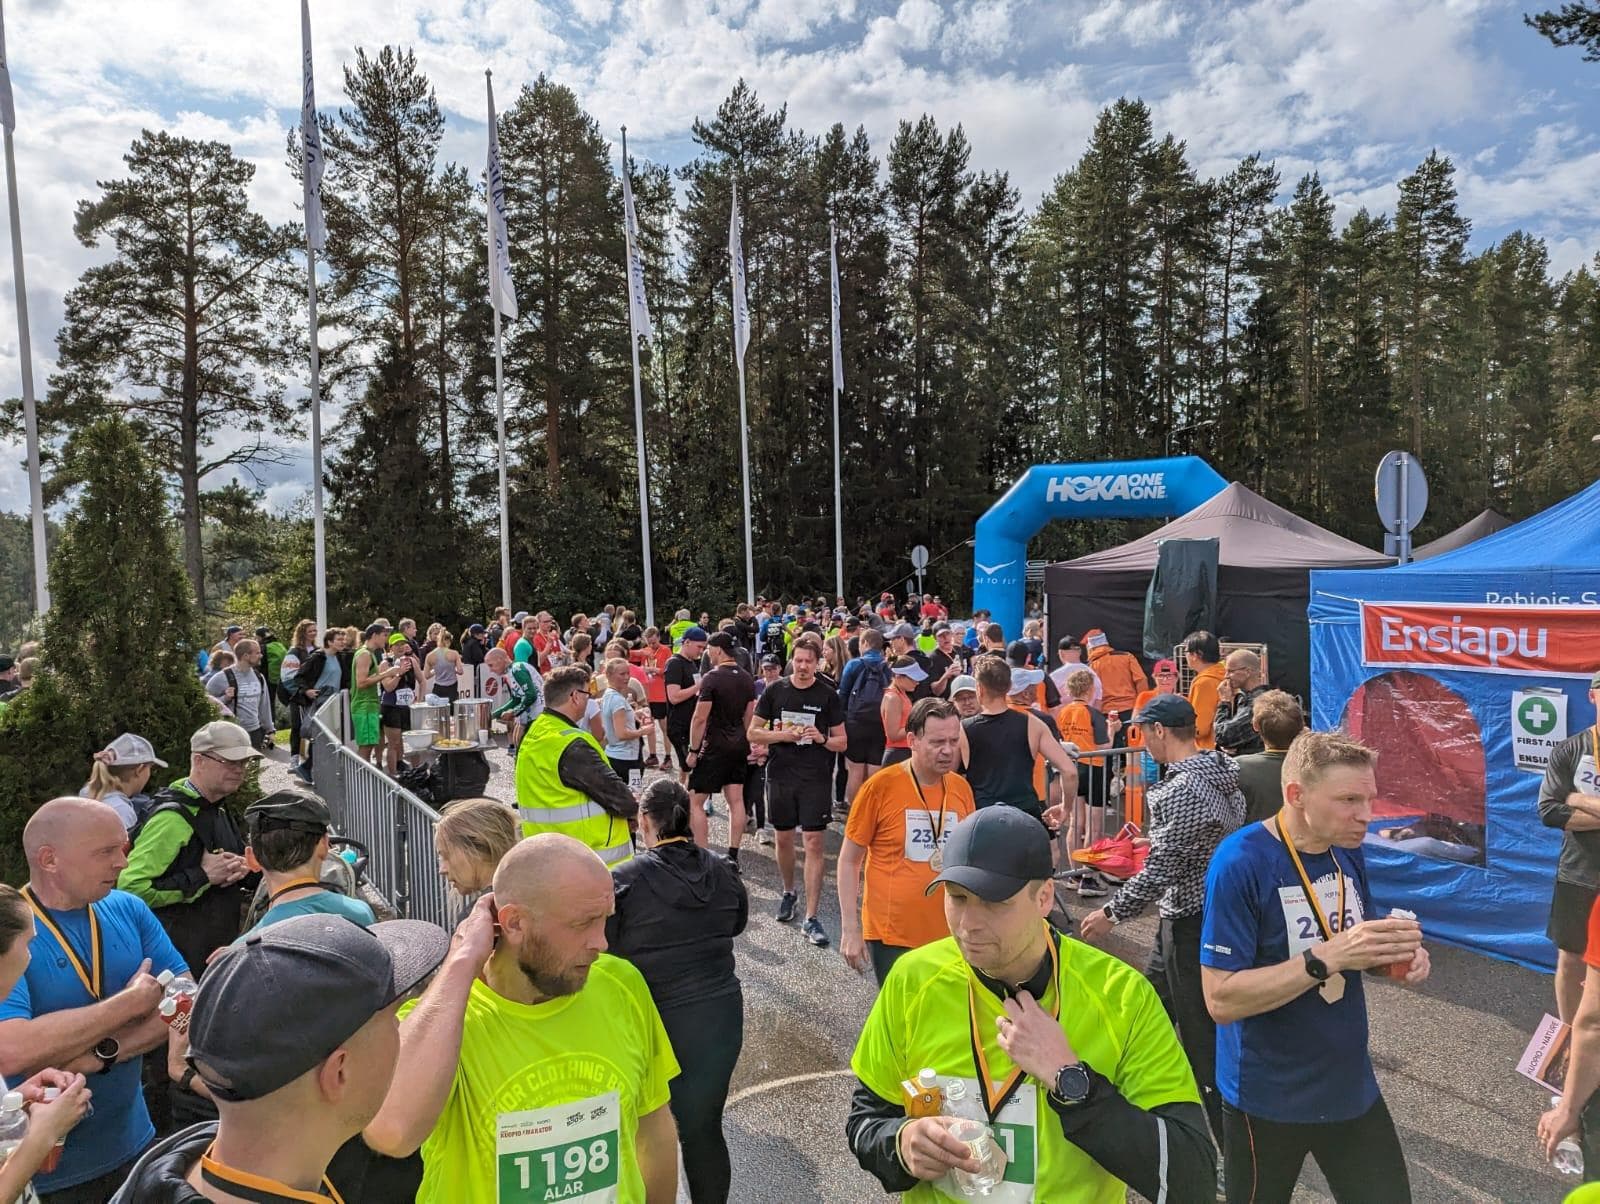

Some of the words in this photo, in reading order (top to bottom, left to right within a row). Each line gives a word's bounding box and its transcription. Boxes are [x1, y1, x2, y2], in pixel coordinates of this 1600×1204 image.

[1046, 475, 1131, 502] HOKA
[1128, 473, 1164, 486] ONE
[1130, 486, 1166, 499] ONE
[1380, 615, 1547, 666] Ensiapu
[1517, 737, 1543, 746] FIRST
[1296, 908, 1355, 939] 266
[1527, 1050, 1543, 1075] KUOPIO
[1542, 1020, 1559, 1046] NATURE
[526, 1060, 605, 1091] CLOTHING
[514, 1139, 610, 1189] 1198
[543, 1181, 584, 1201] ALAR
